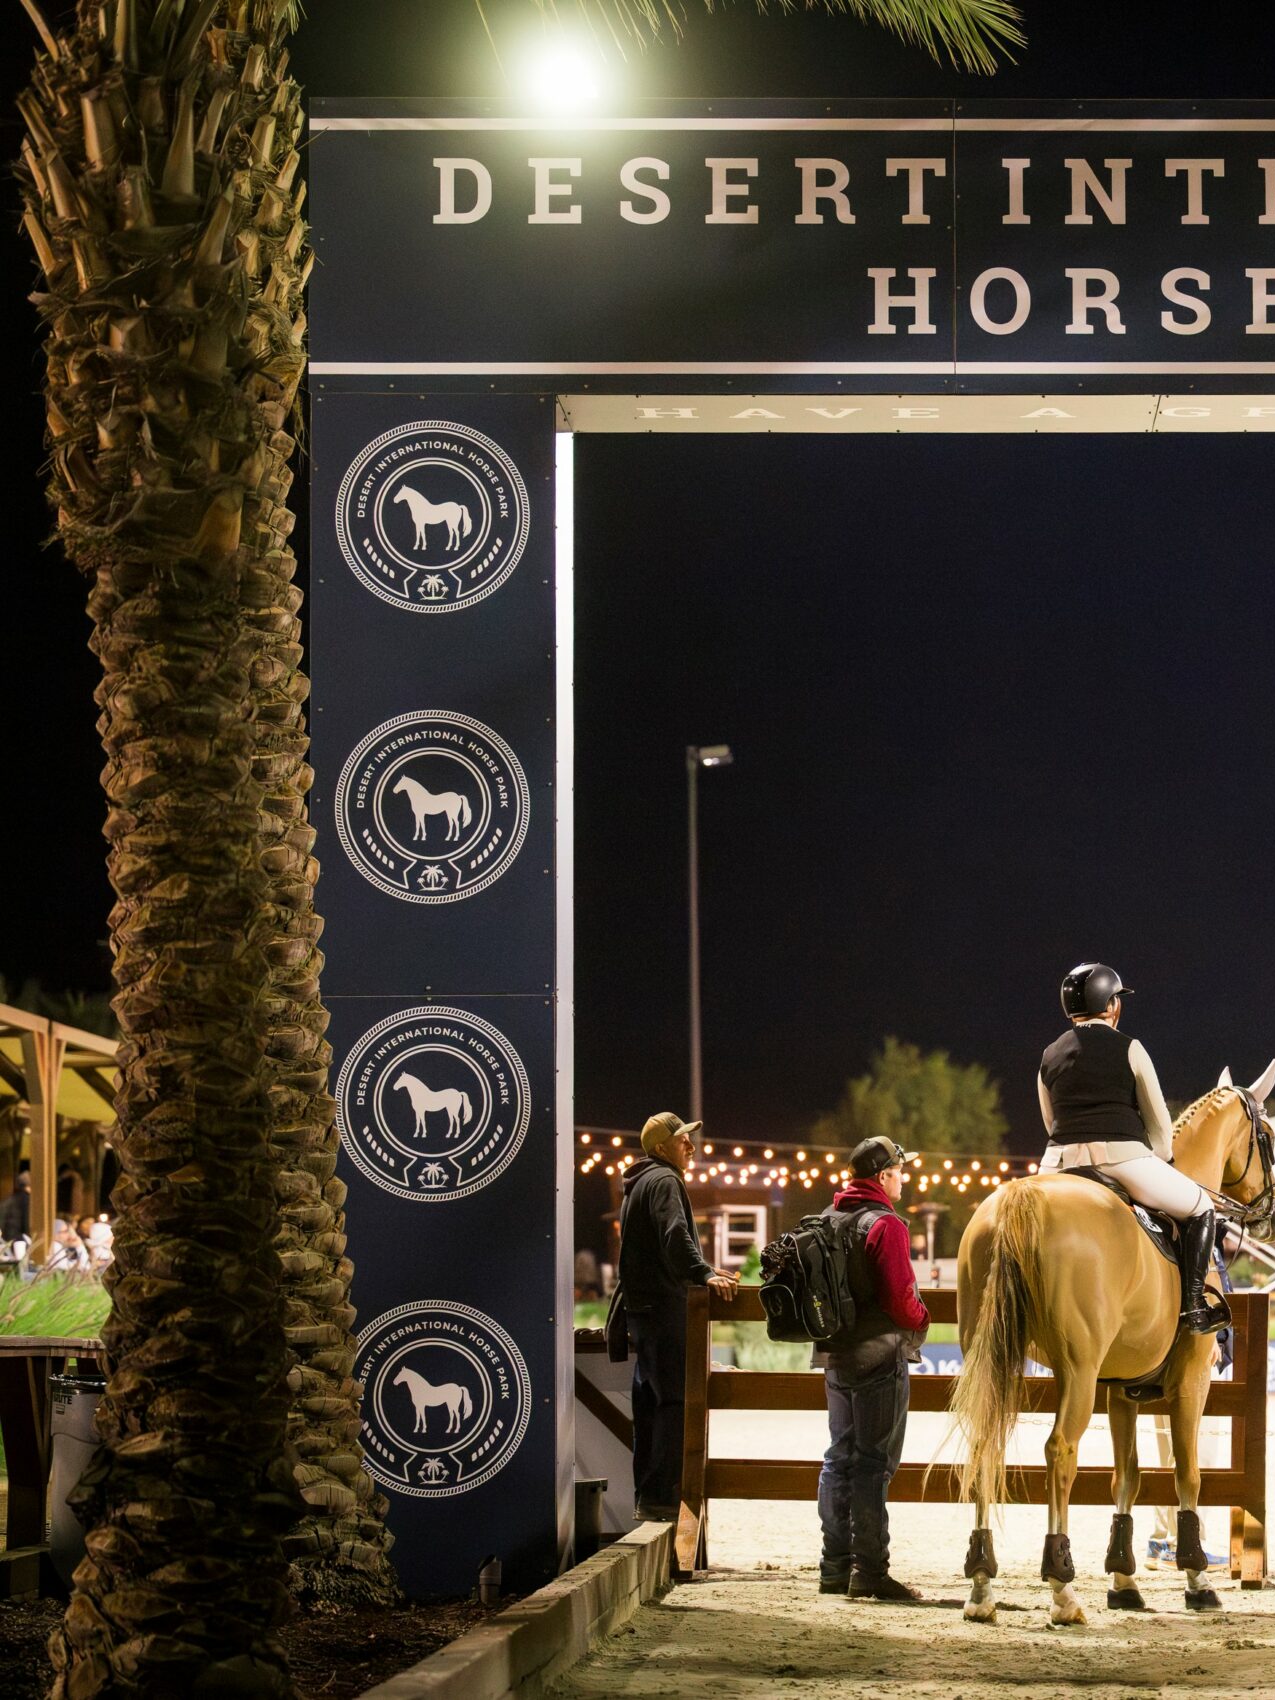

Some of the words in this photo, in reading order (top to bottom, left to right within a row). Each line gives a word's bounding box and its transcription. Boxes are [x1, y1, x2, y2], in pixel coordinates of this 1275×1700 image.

[433, 157, 946, 225] DESERT
[636, 407, 941, 419] HAVE
[1020, 407, 1077, 419] A
[357, 473, 376, 518] DESERT
[374, 440, 464, 473] INTERNATIONAL
[467, 451, 500, 485] HORSE
[495, 486, 509, 518] PARK
[356, 763, 376, 809] DESERT
[374, 730, 464, 764] INTERNATIONAL
[467, 741, 500, 774] HORSE
[495, 776, 509, 808] PARK
[356, 1060, 376, 1106] DESERT
[374, 1026, 465, 1060] INTERNATIONAL
[468, 1037, 500, 1071] HORSE
[496, 1072, 510, 1105] PARK
[374, 1321, 465, 1355] INTERNATIONAL
[468, 1331, 501, 1365] HORSE
[496, 1366, 510, 1400] PARK
